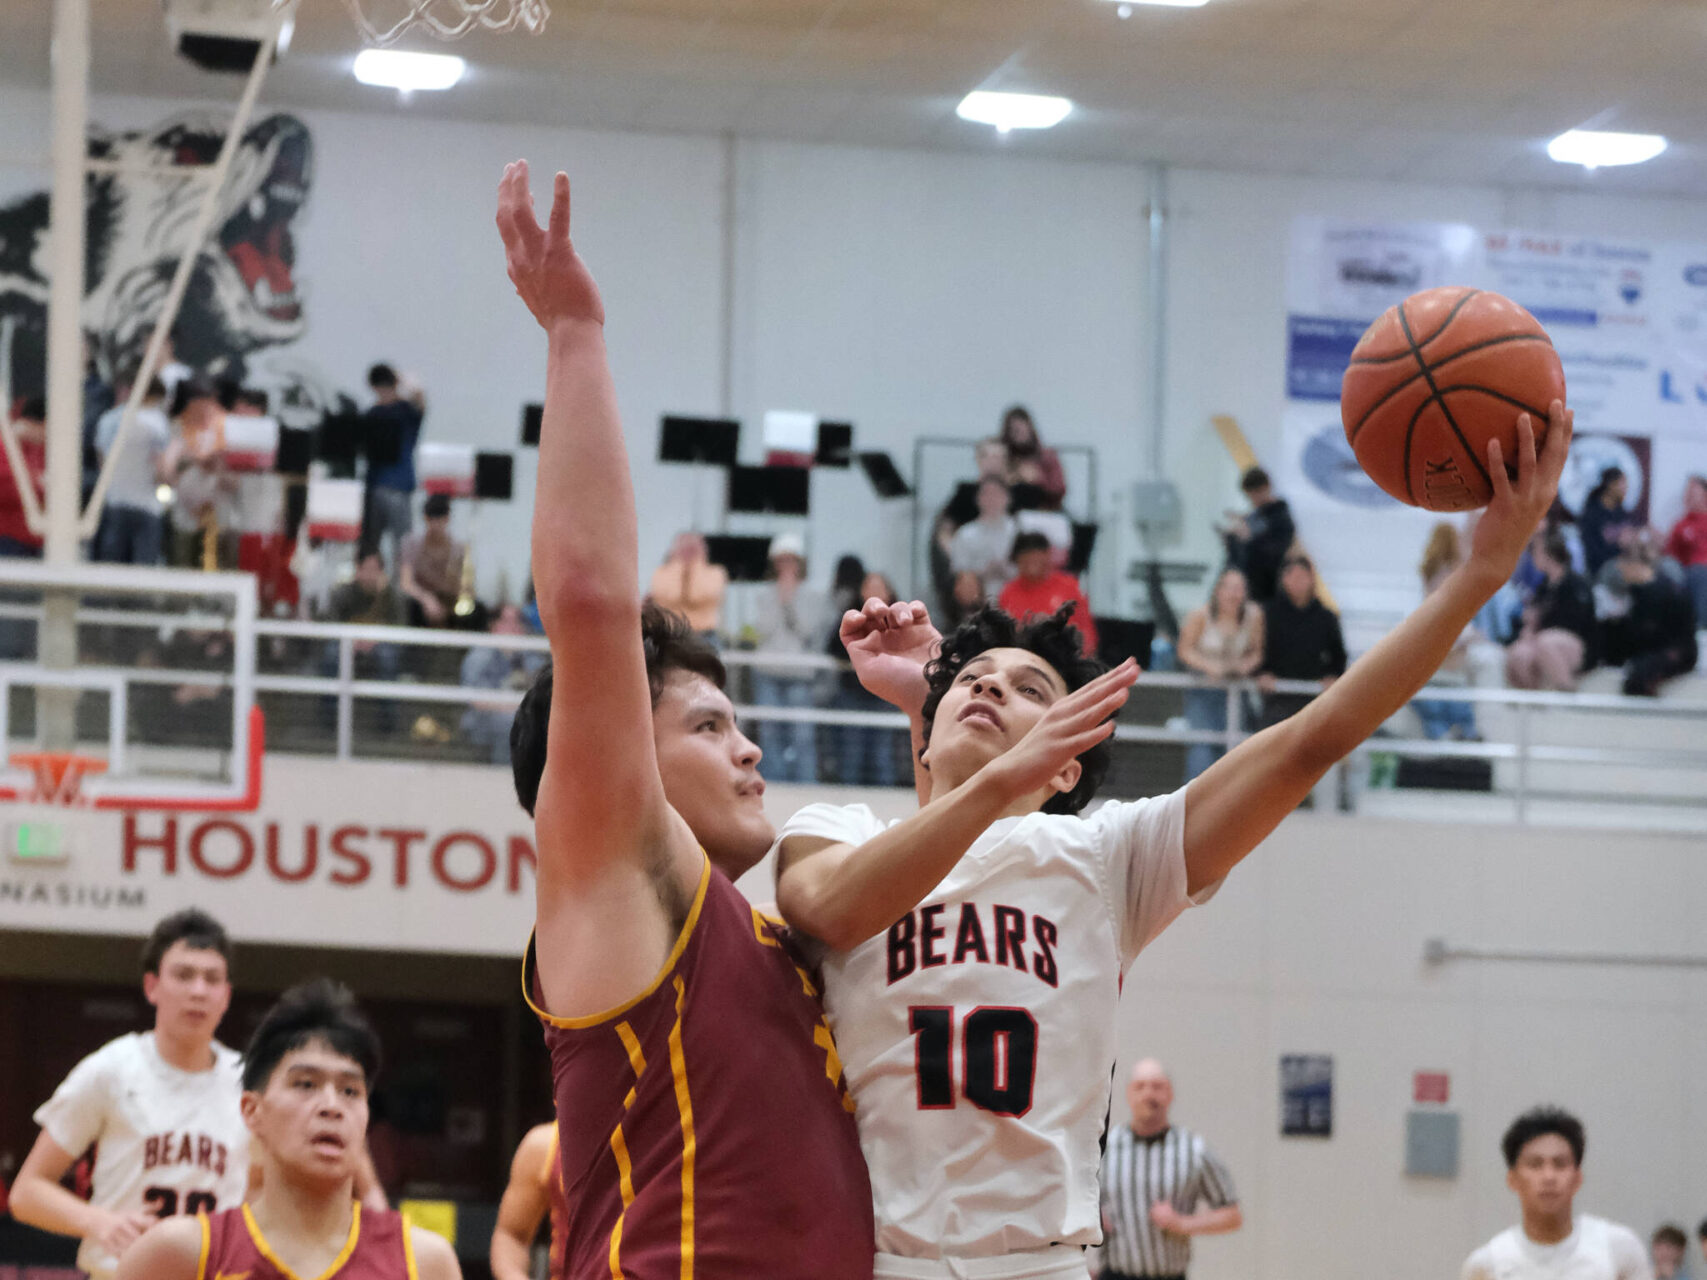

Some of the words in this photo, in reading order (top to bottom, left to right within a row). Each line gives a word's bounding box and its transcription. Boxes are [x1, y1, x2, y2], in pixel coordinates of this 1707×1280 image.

[887, 902, 1058, 988] BEARS
[908, 1005, 1038, 1119] 10
[144, 1131, 227, 1177] BEARS
